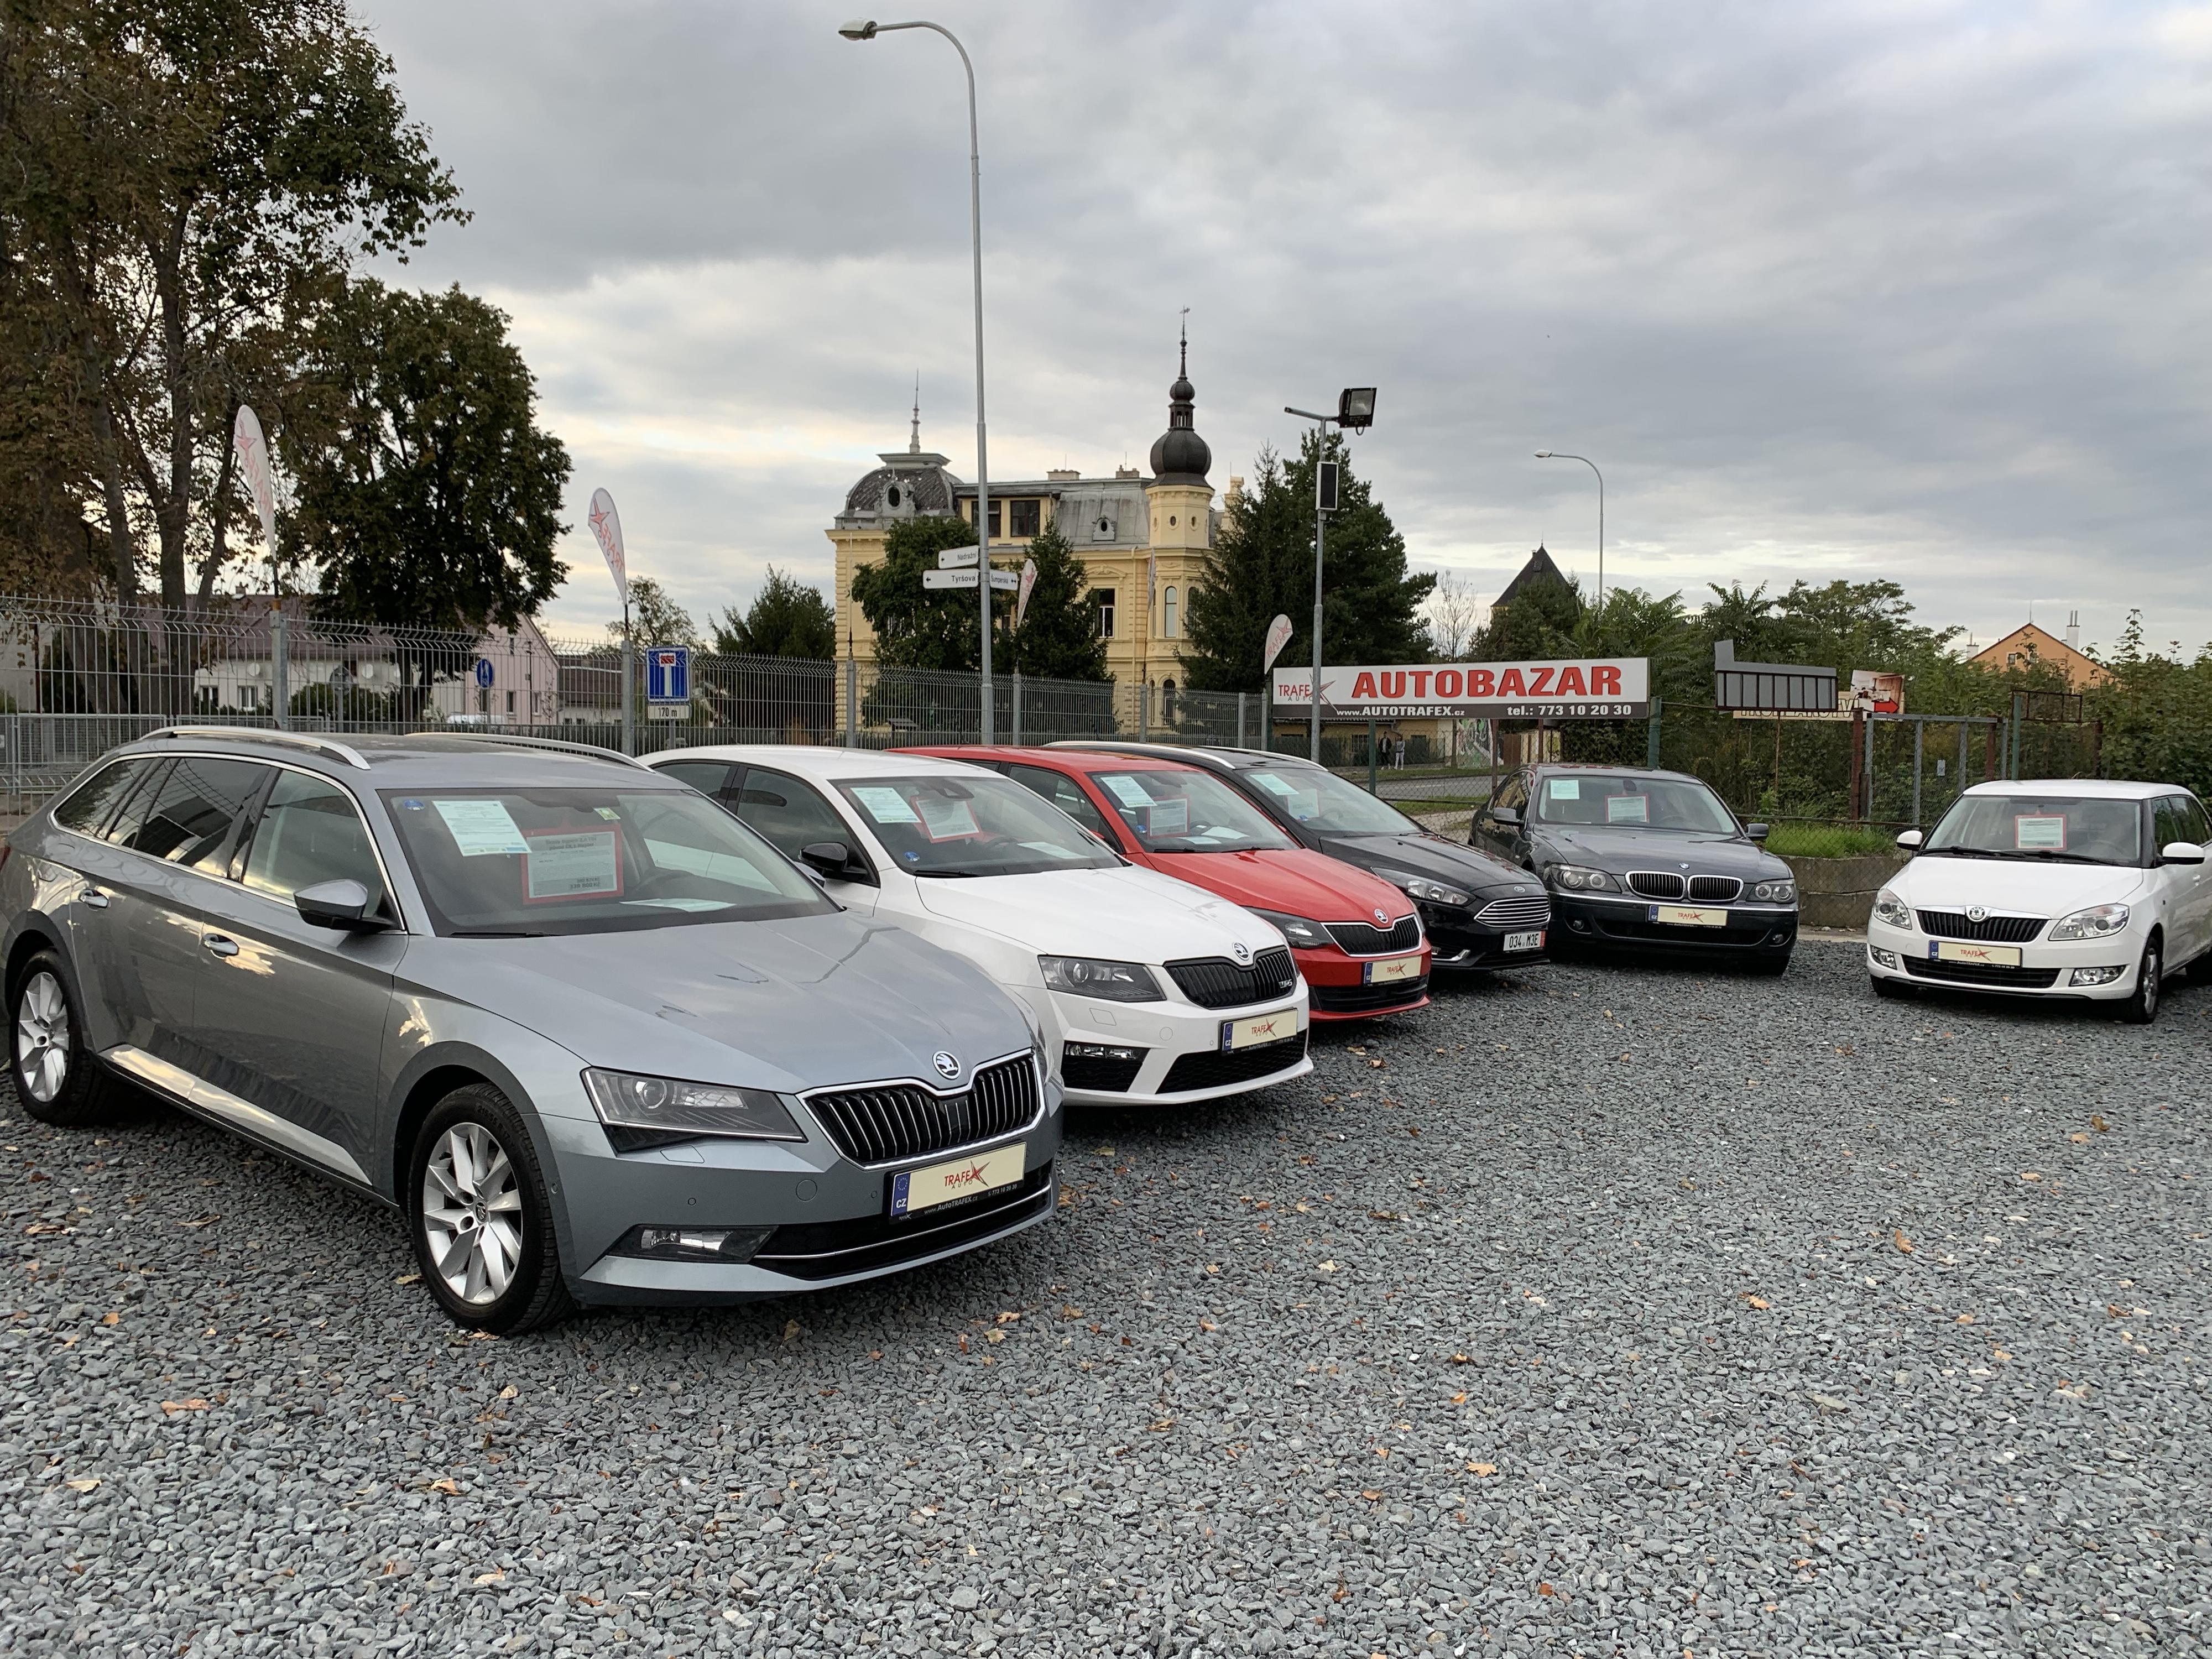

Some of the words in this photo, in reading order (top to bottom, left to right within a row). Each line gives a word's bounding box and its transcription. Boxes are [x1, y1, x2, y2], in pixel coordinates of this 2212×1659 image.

[951, 574, 975, 583] Tyršova
[990, 575, 1009, 585] Šumperská
[1351, 666, 1621, 698] AUTOBAZAR
[658, 707, 669, 717] 170
[1336, 706, 1465, 716] www.AUTOTRAFEX.cz
[1507, 706, 1533, 716] tel.:
[1538, 705, 1564, 716] 773
[1569, 705, 1586, 716] 10
[1590, 705, 1609, 715] 20
[1613, 705, 1632, 715] 30
[1509, 935, 1522, 948] 034
[1526, 933, 1539, 947] M3E
[951, 1180, 973, 1190] AUTO
[896, 1198, 907, 1208] CZ
[924, 1195, 978, 1215] www.AutoTRAFEX.cz
